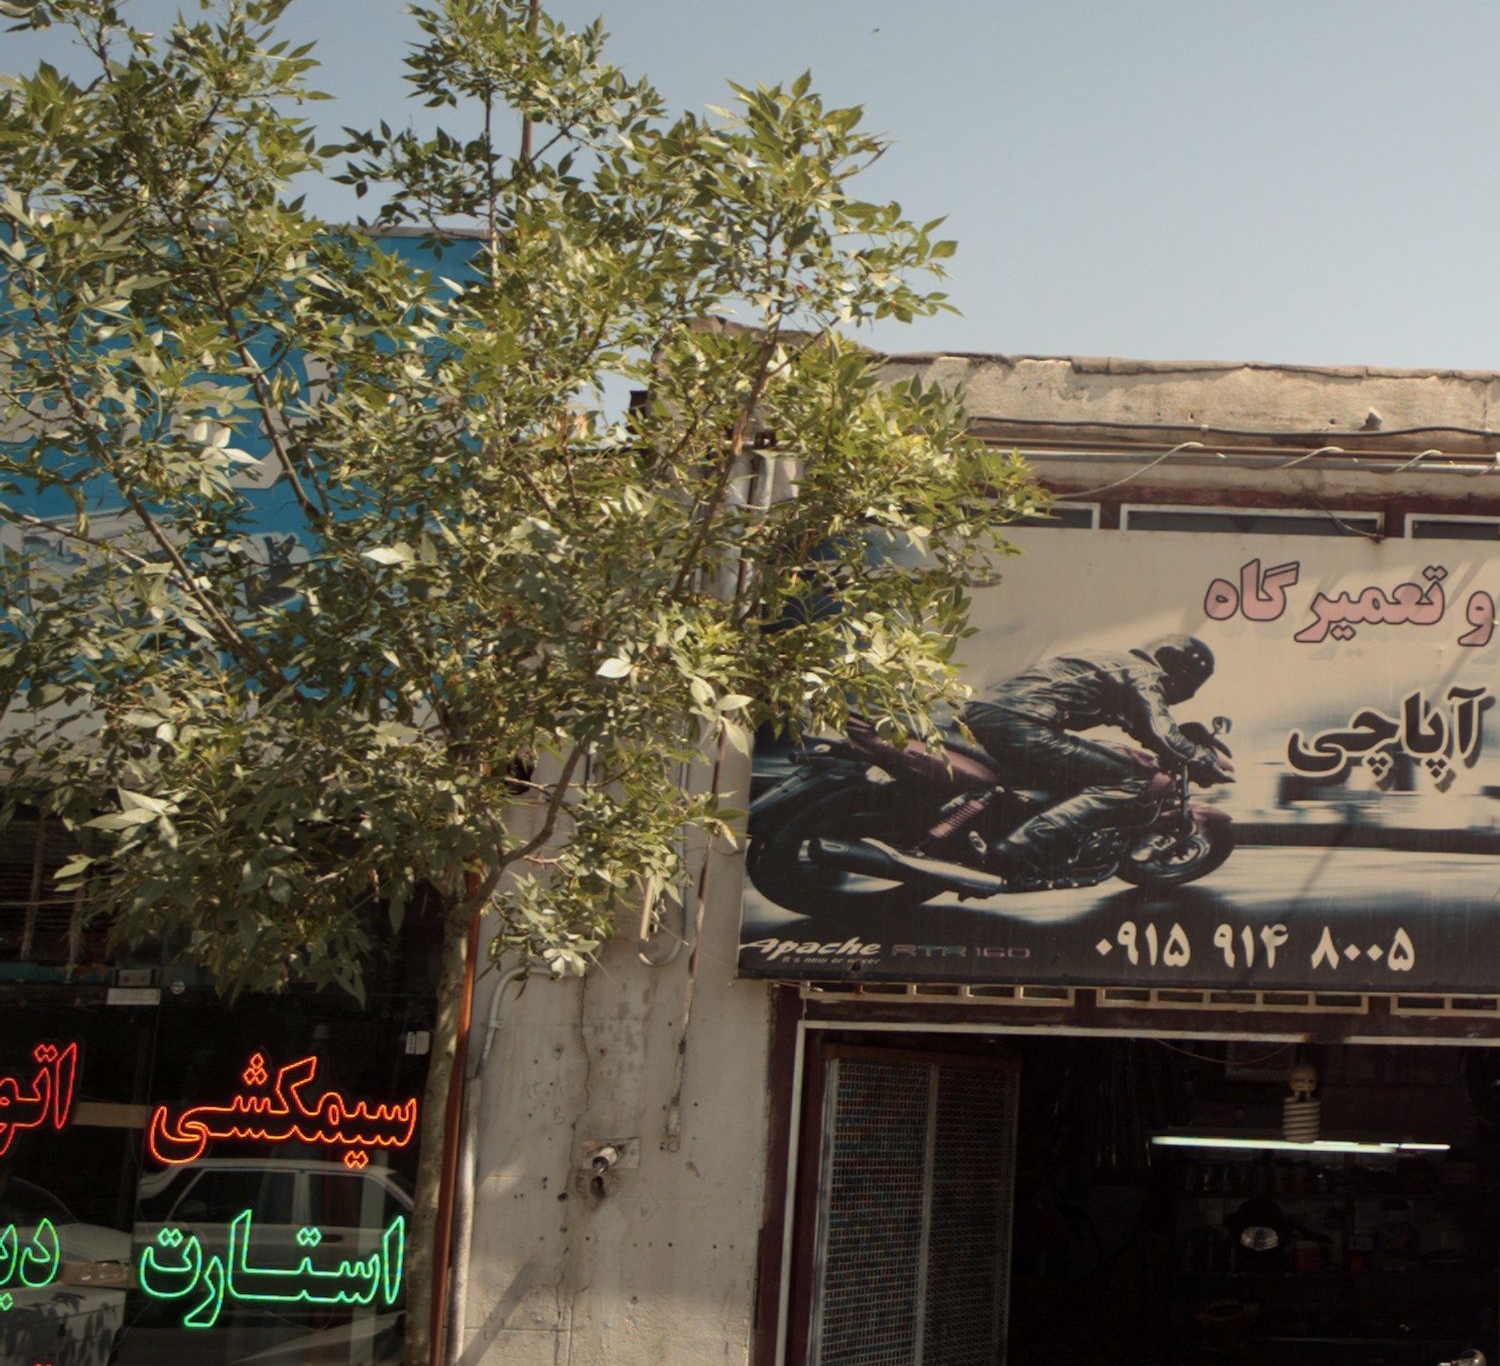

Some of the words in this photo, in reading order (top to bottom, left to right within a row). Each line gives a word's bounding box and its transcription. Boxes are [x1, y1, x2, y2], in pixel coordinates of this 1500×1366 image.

[1457, 589, 1496, 647] و
[1286, 683, 1494, 781] آپاچی
[738, 936, 882, 961] Apache
[1096, 921, 1191, 967] ۰۹۱۵
[1214, 923, 1289, 969] ۹۱۴
[1310, 925, 1415, 972] ۸۰۰۵
[150, 1052, 418, 1170] سیمکشی
[139, 1208, 406, 1328] استارت
